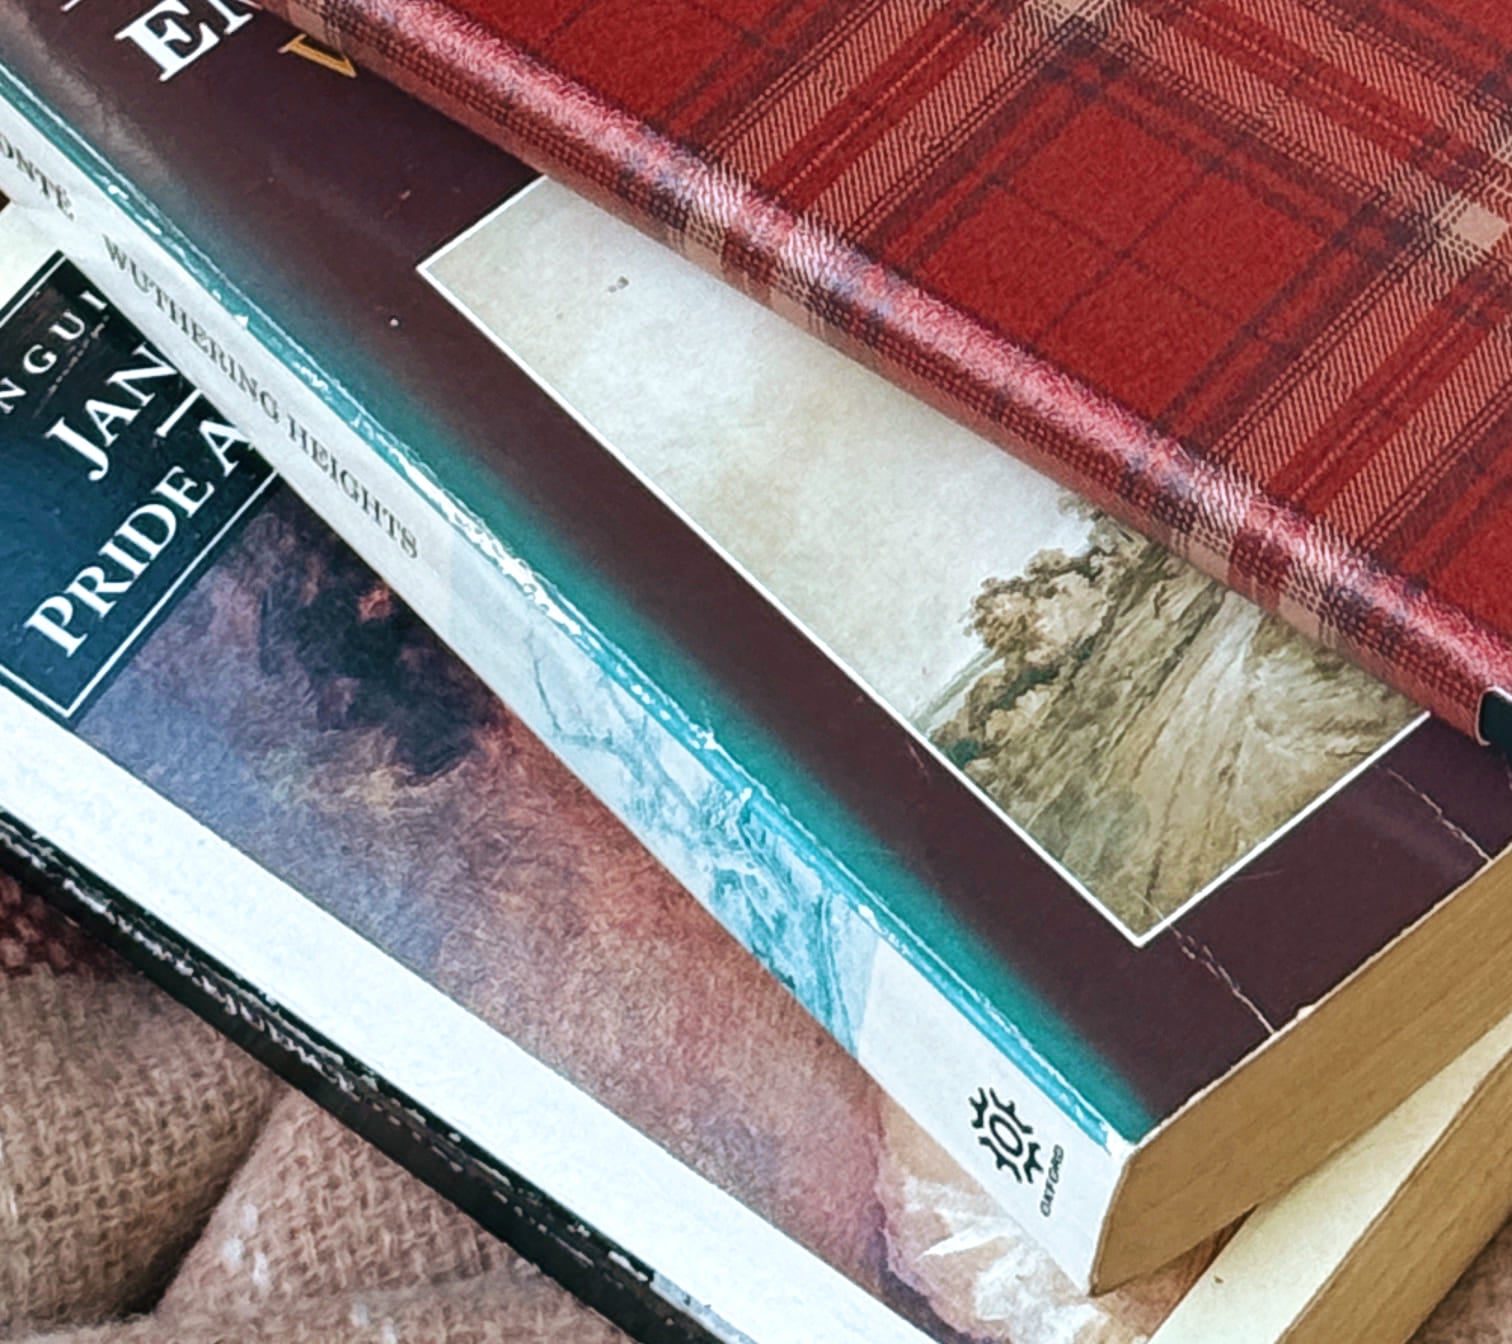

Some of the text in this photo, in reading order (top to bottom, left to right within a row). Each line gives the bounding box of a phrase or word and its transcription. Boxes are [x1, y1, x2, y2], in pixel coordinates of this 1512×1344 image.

[44, 342, 178, 482] JAN
[102, 233, 281, 425] WUTHERING
[287, 414, 419, 559] HEIGHTS
[23, 465, 215, 658] PRIDE
[1039, 1143, 1065, 1218] OXFORD
